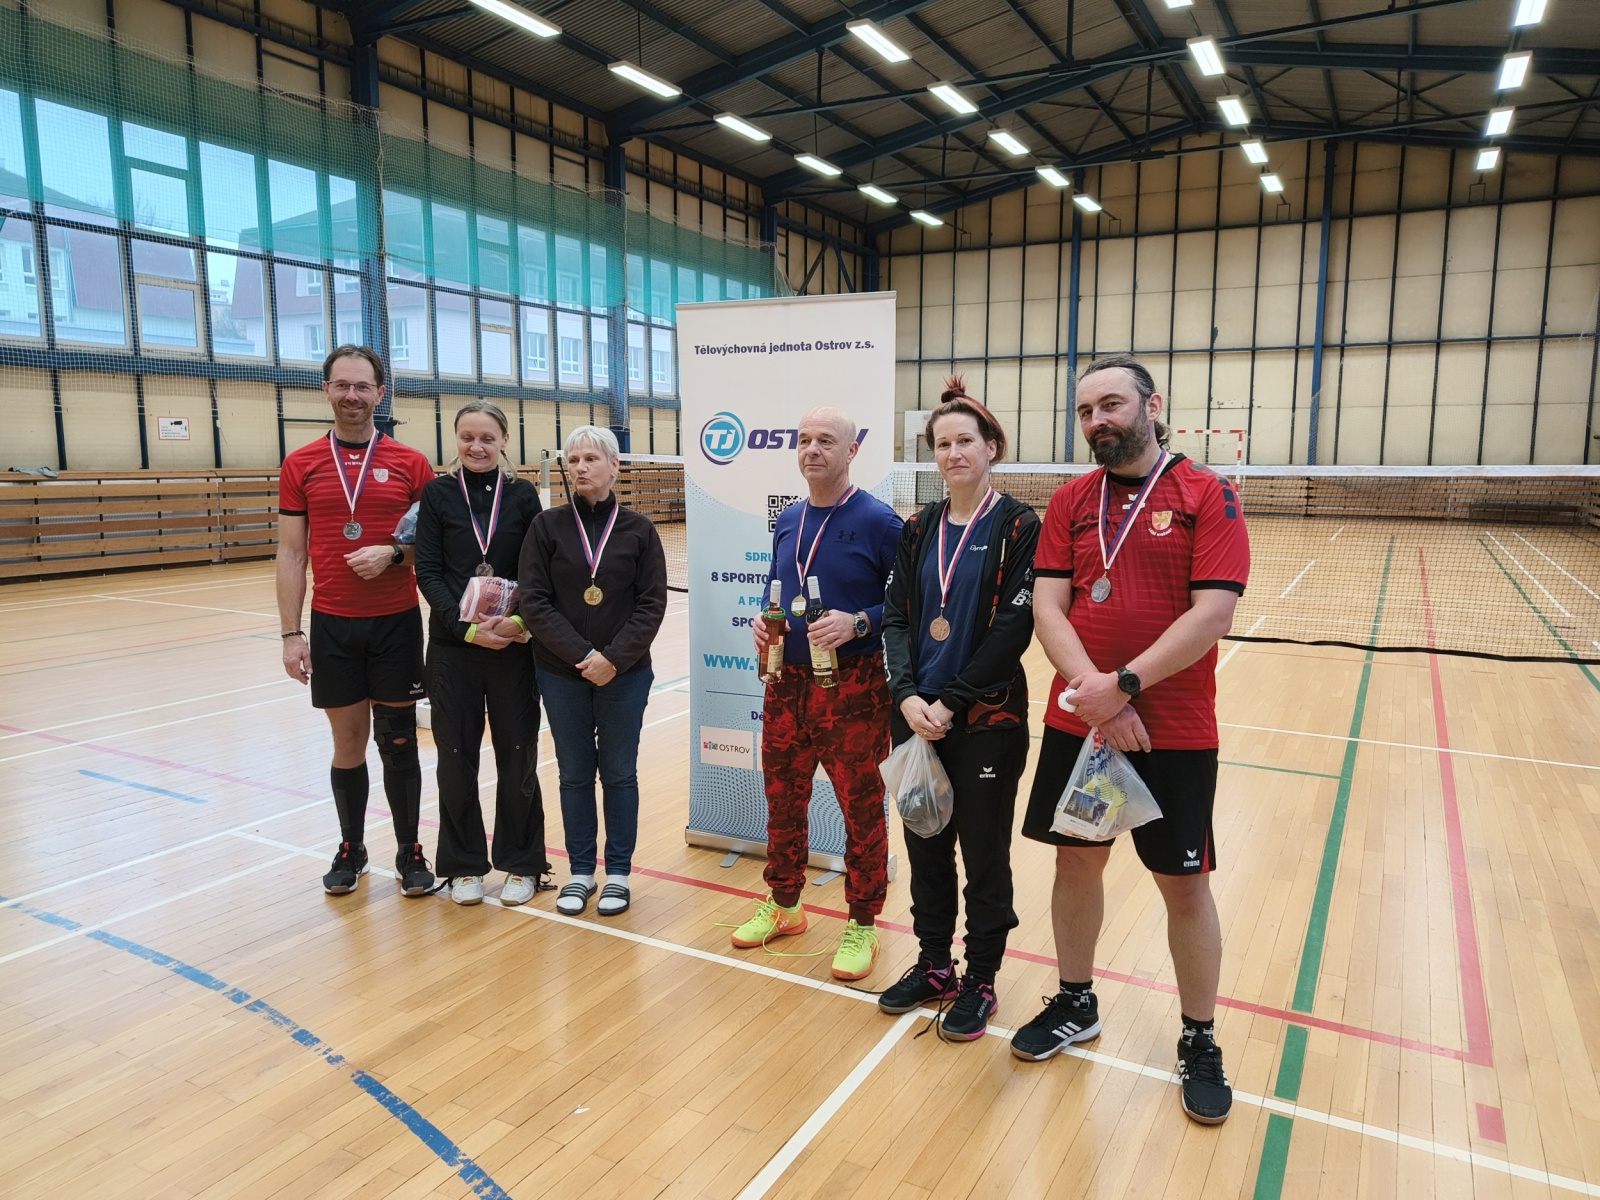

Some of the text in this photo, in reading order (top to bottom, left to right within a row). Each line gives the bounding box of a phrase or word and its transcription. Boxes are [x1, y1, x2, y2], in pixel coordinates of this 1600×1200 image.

[694, 340, 875, 356] Tělovýchovná jednota Ostrov z.s.
[705, 429, 737, 450] TJ
[711, 571, 769, 585] 8 SPORTO
[738, 596, 746, 606] A
[732, 616, 755, 628] SPO
[750, 710, 764, 721] Dě
[719, 743, 751, 754] OSTROV
